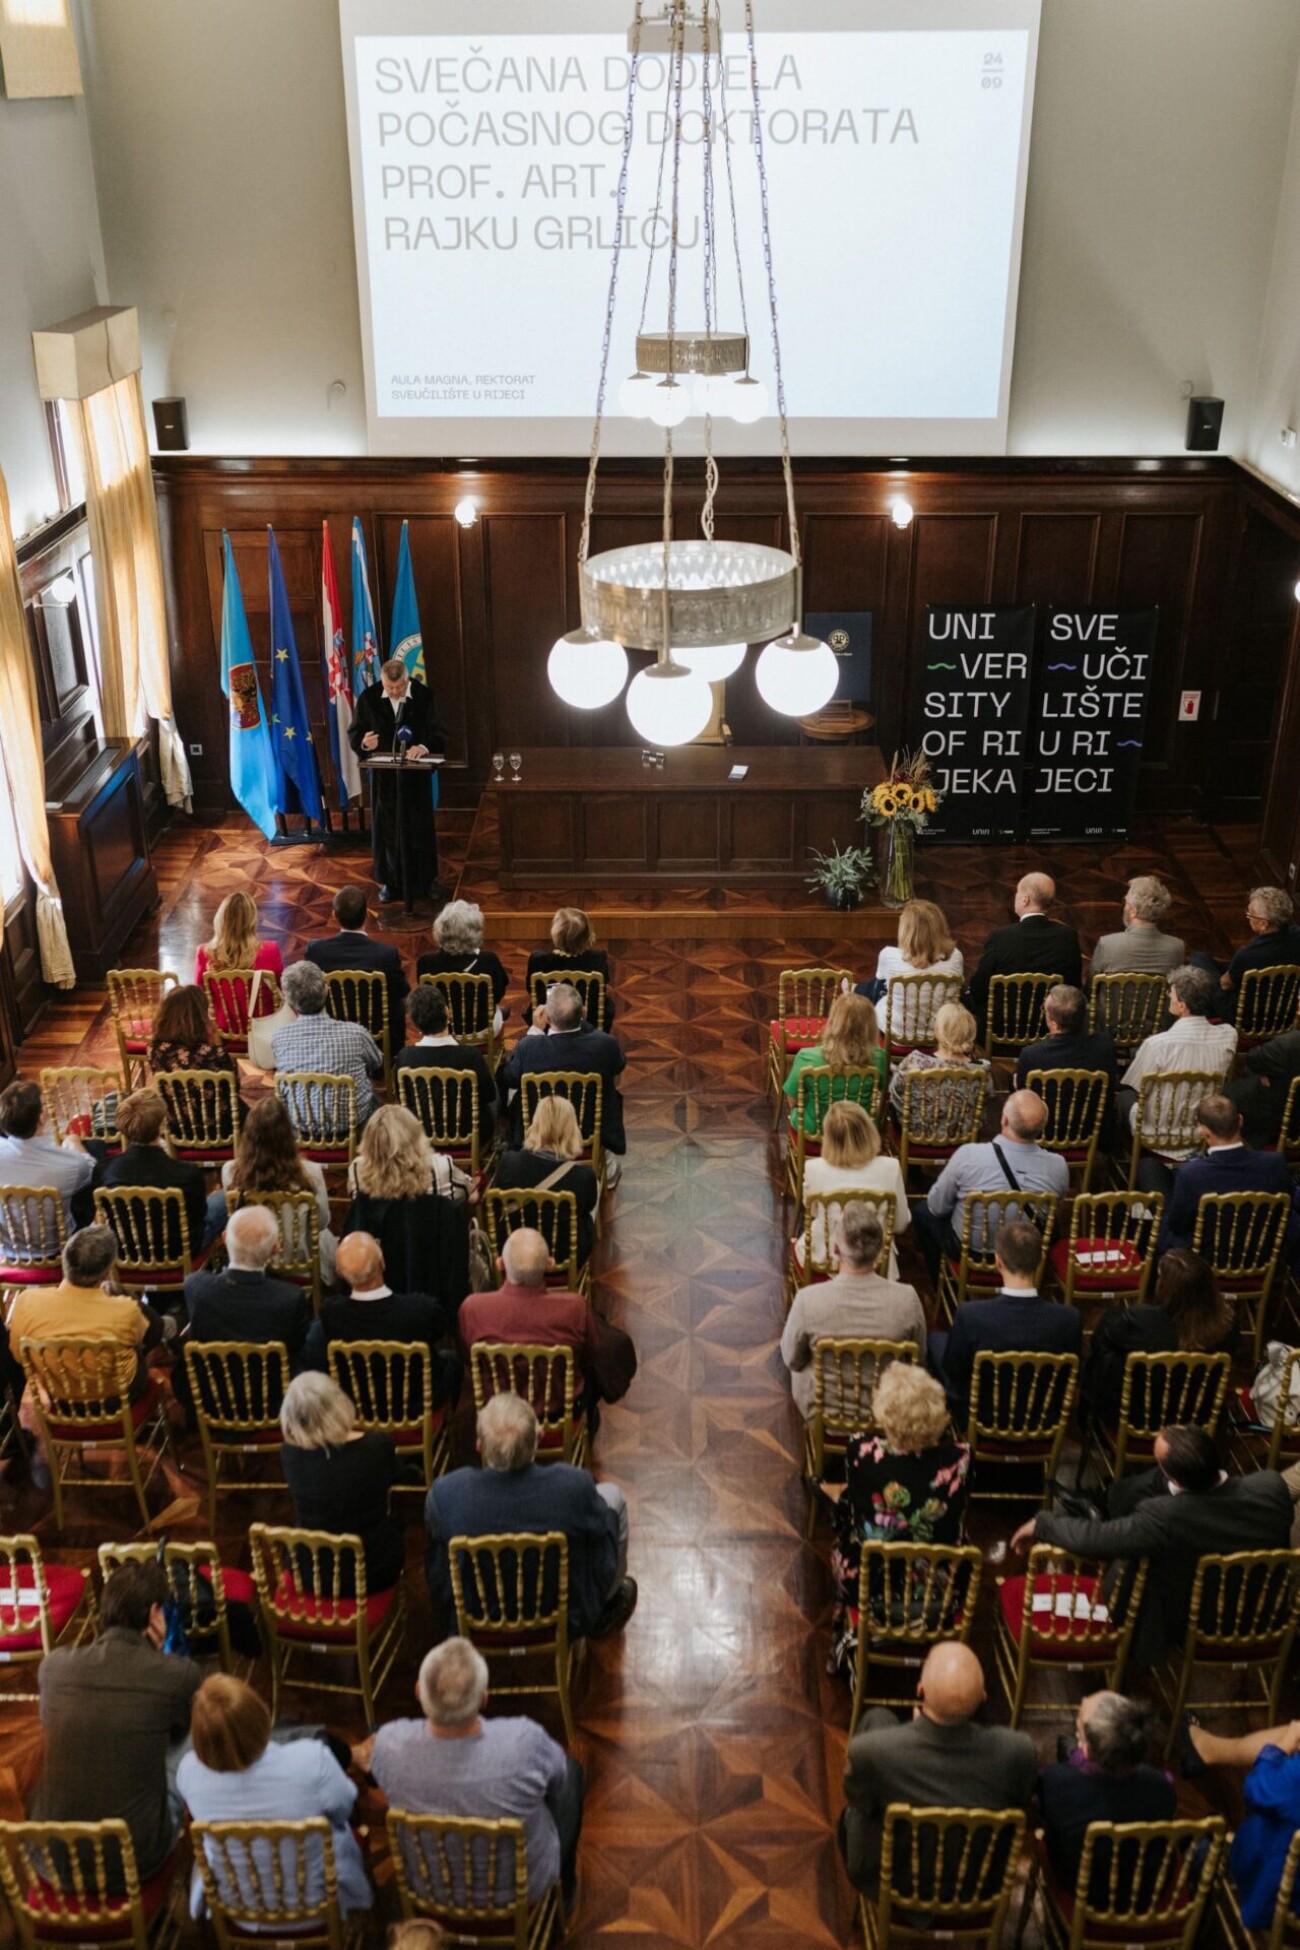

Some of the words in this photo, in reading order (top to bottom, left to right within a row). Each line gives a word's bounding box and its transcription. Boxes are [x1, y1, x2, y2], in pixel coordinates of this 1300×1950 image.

[375, 45, 588, 94] SVEČANA
[603, 54, 802, 92] DODJELA
[983, 51, 1003, 66] 24
[378, 100, 628, 147] POČASNOG
[646, 109, 919, 145] DOKTORATA
[381, 164, 504, 199] PROF.
[521, 163, 618, 199] ART.
[384, 216, 518, 250] RAJKU
[391, 374, 422, 385] AULA
[424, 374, 472, 386] MAGNA,
[475, 374, 536, 385] REKTORAT
[391, 387, 469, 400] SVEUČILIŠTE
[473, 389, 481, 400] U
[485, 389, 525, 400] RIJECI
[929, 613, 996, 640] UNI
[1050, 614, 1119, 641] SVE
[960, 653, 1028, 679] VER
[1082, 646, 1149, 680] UČI
[924, 692, 1011, 718] SITY
[1042, 685, 1144, 718] LIŠTE
[922, 730, 967, 756] OF
[982, 730, 1022, 756] RI
[1039, 730, 1061, 756] U
[1072, 730, 1111, 756] RI
[935, 768, 1017, 794] JEKA
[1035, 768, 1115, 793] JECI
